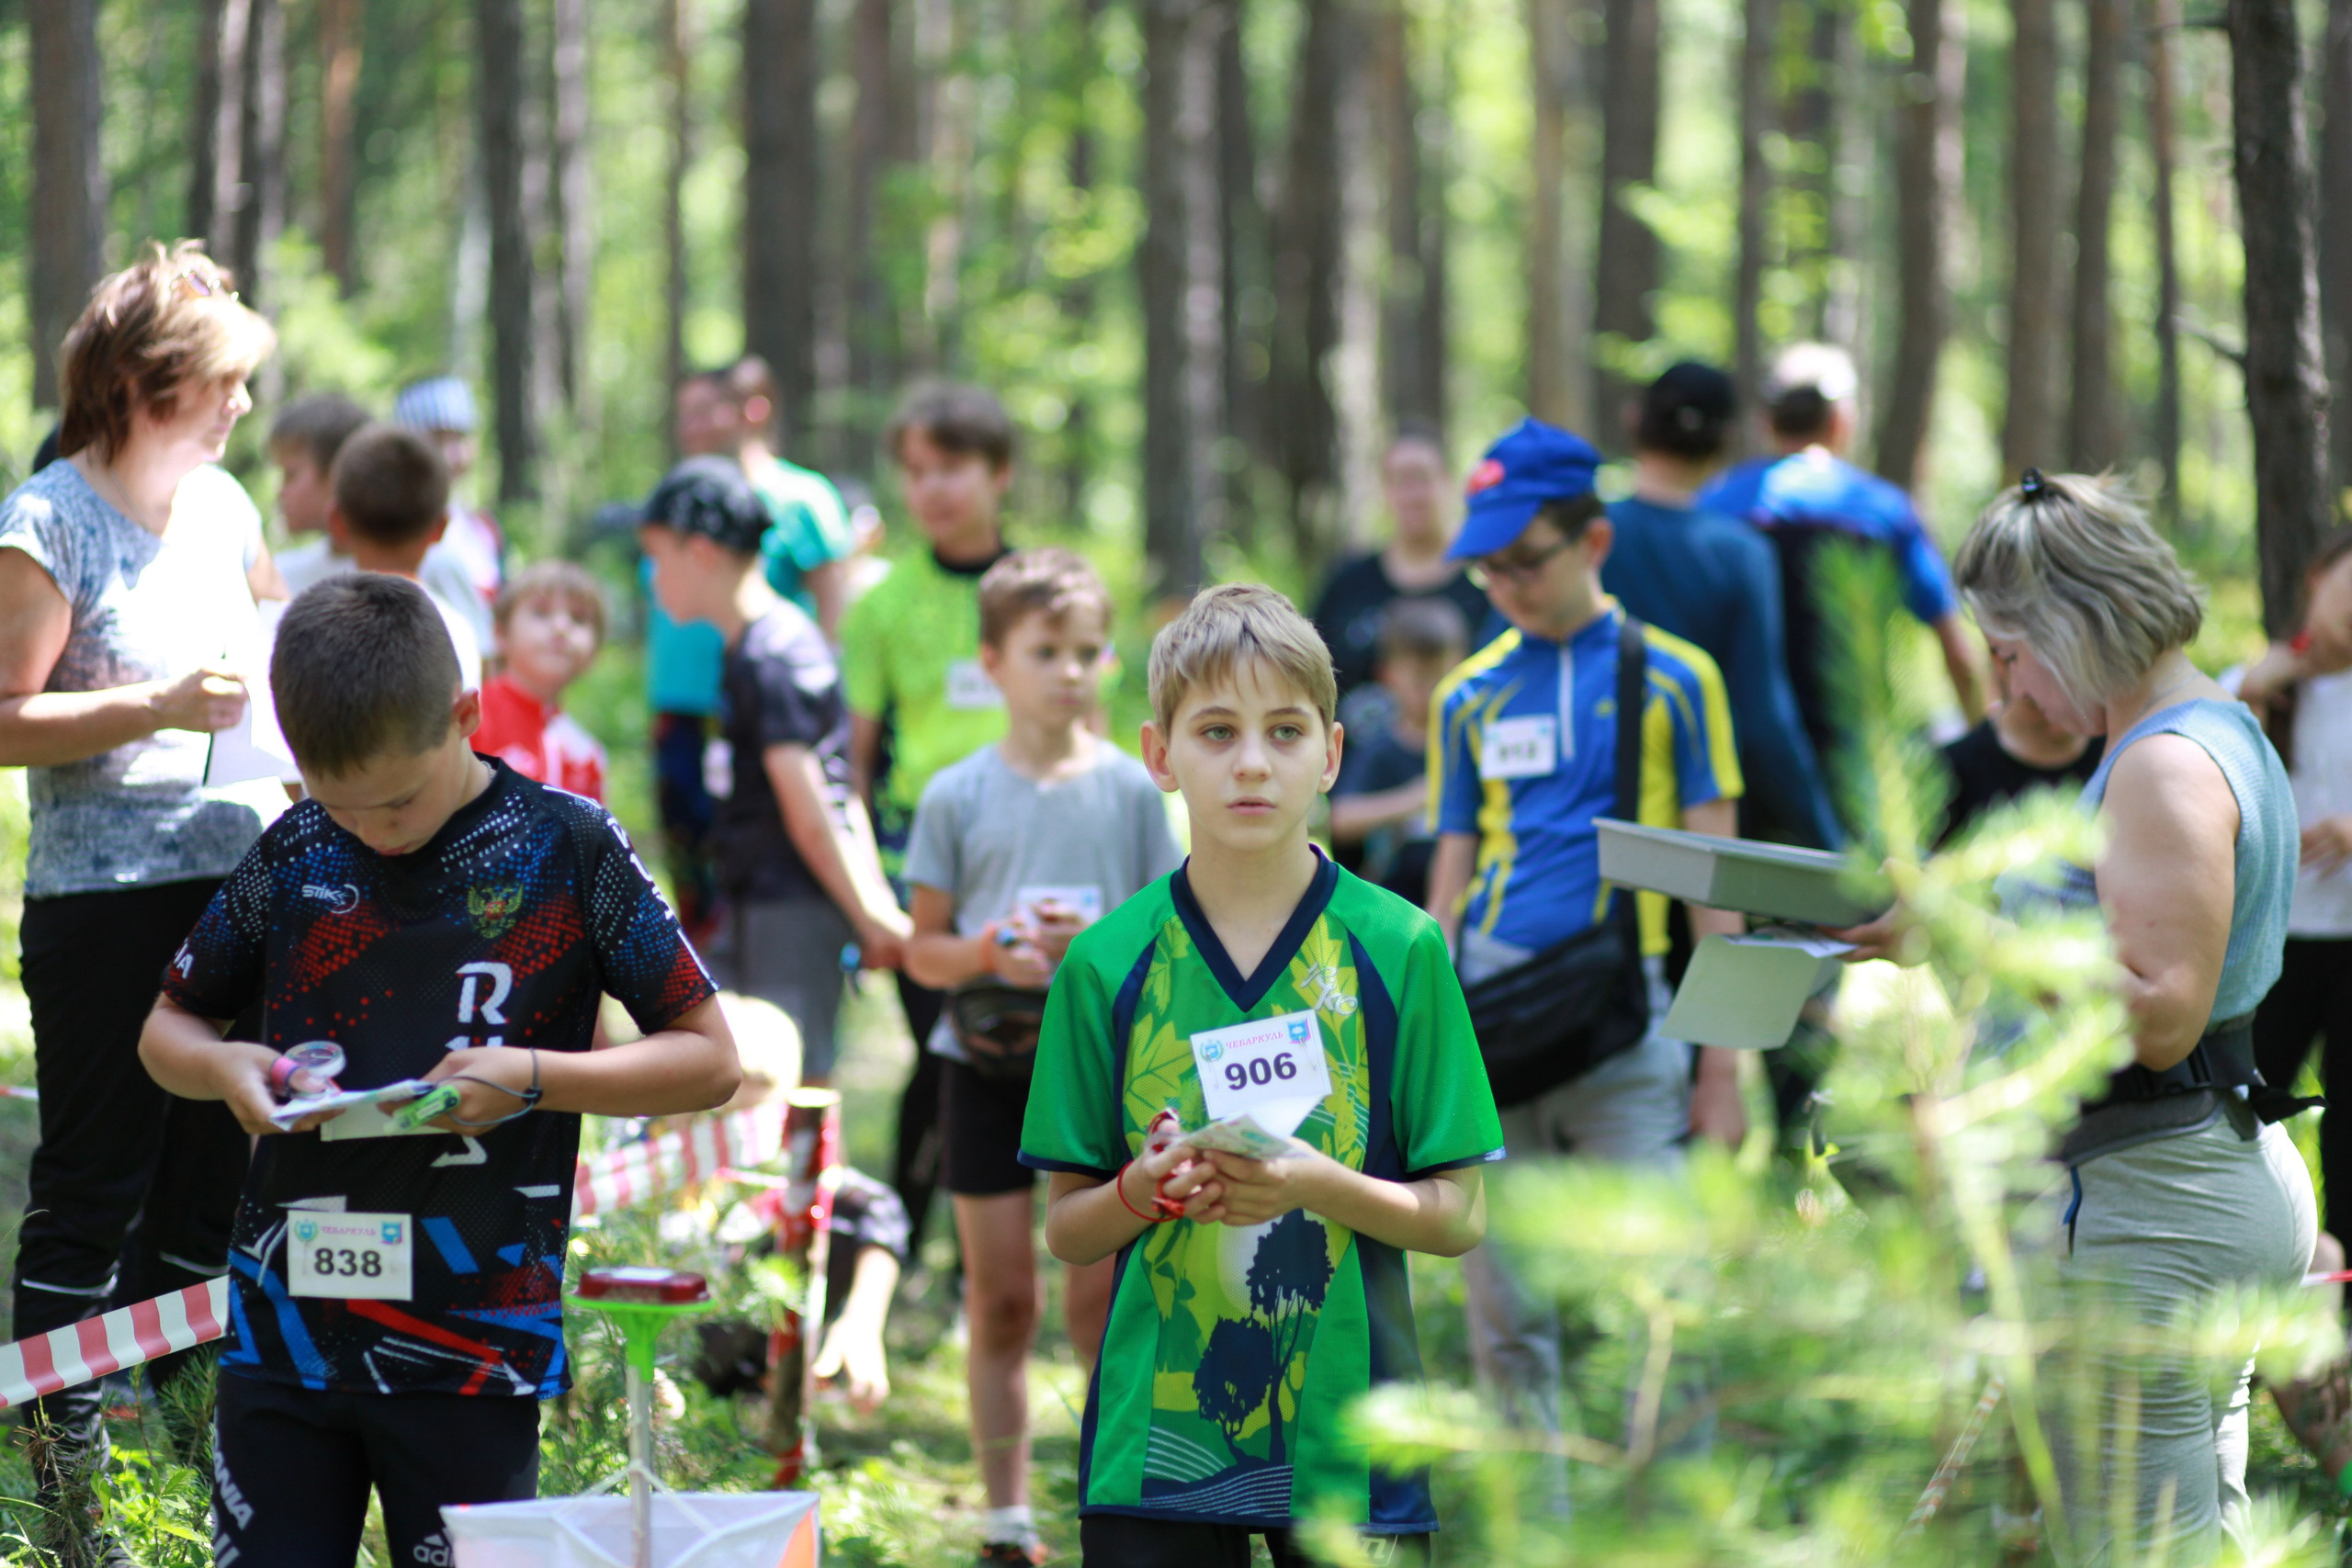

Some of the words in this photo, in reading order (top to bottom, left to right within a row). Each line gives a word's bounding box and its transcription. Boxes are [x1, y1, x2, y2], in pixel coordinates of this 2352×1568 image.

[1225, 1031, 1284, 1049] ЧЕБАРКУЛЬ
[1225, 1052, 1297, 1090] 906
[321, 1225, 377, 1236] ЧЕБАРКУЛЬ
[314, 1247, 382, 1278] 838
